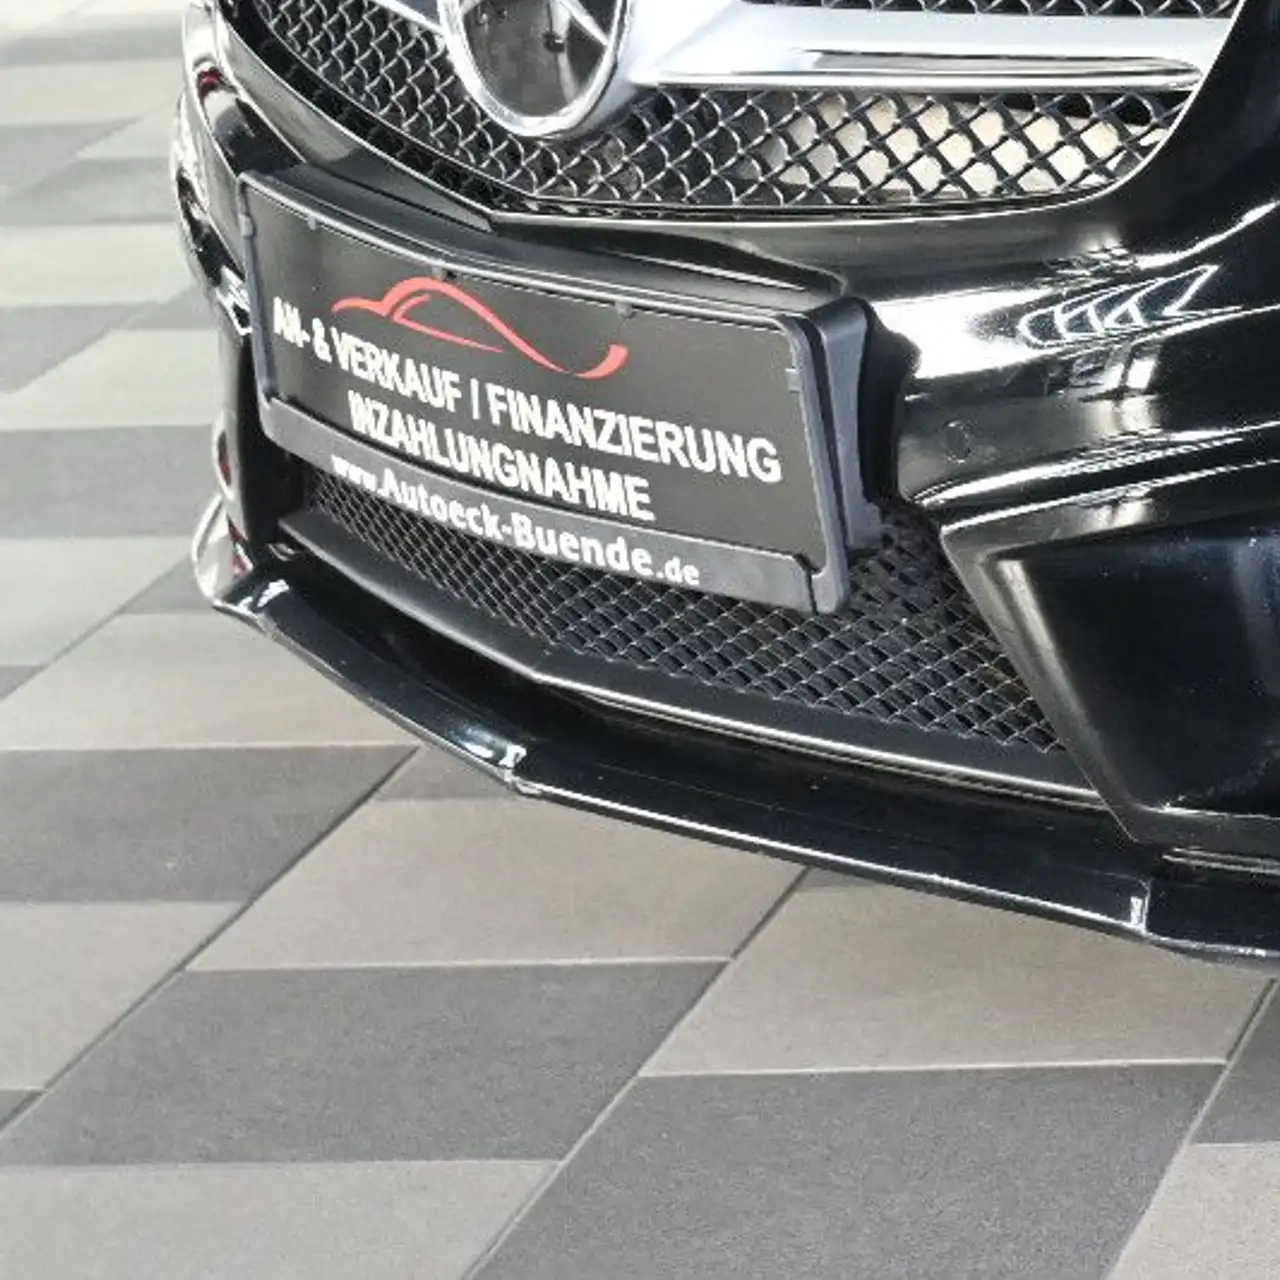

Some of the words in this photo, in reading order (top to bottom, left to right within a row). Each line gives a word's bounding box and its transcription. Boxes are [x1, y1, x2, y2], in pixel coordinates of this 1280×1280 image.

[311, 318, 332, 364] &
[331, 326, 462, 413] VERKAUF
[486, 382, 784, 484] FINANZIERUNG
[348, 389, 657, 522] INZAHLUNGNAHME
[330, 453, 700, 587] www.Autoeck-Buende.de
